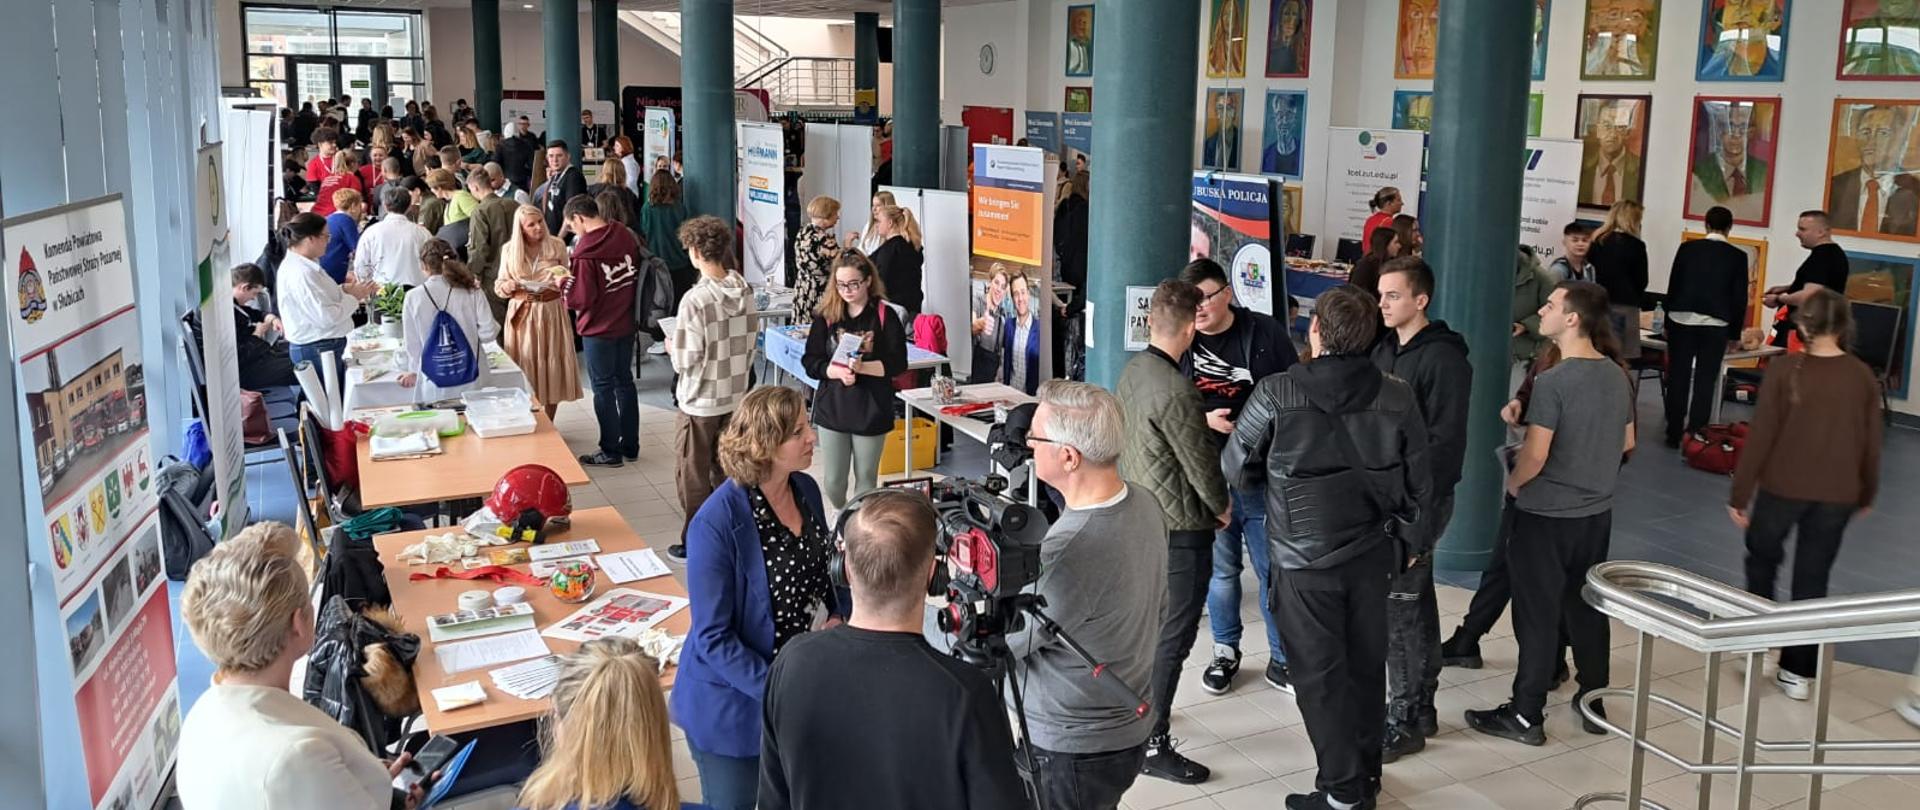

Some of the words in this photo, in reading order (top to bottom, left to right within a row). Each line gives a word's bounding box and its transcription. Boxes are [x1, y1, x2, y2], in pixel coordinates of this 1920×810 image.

[657, 97, 682, 107] wies
[1228, 189, 1268, 204] POLICJA
[44, 241, 72, 259] Komenda
[73, 231, 102, 249] Powiatowa
[48, 263, 83, 286] Państwowej
